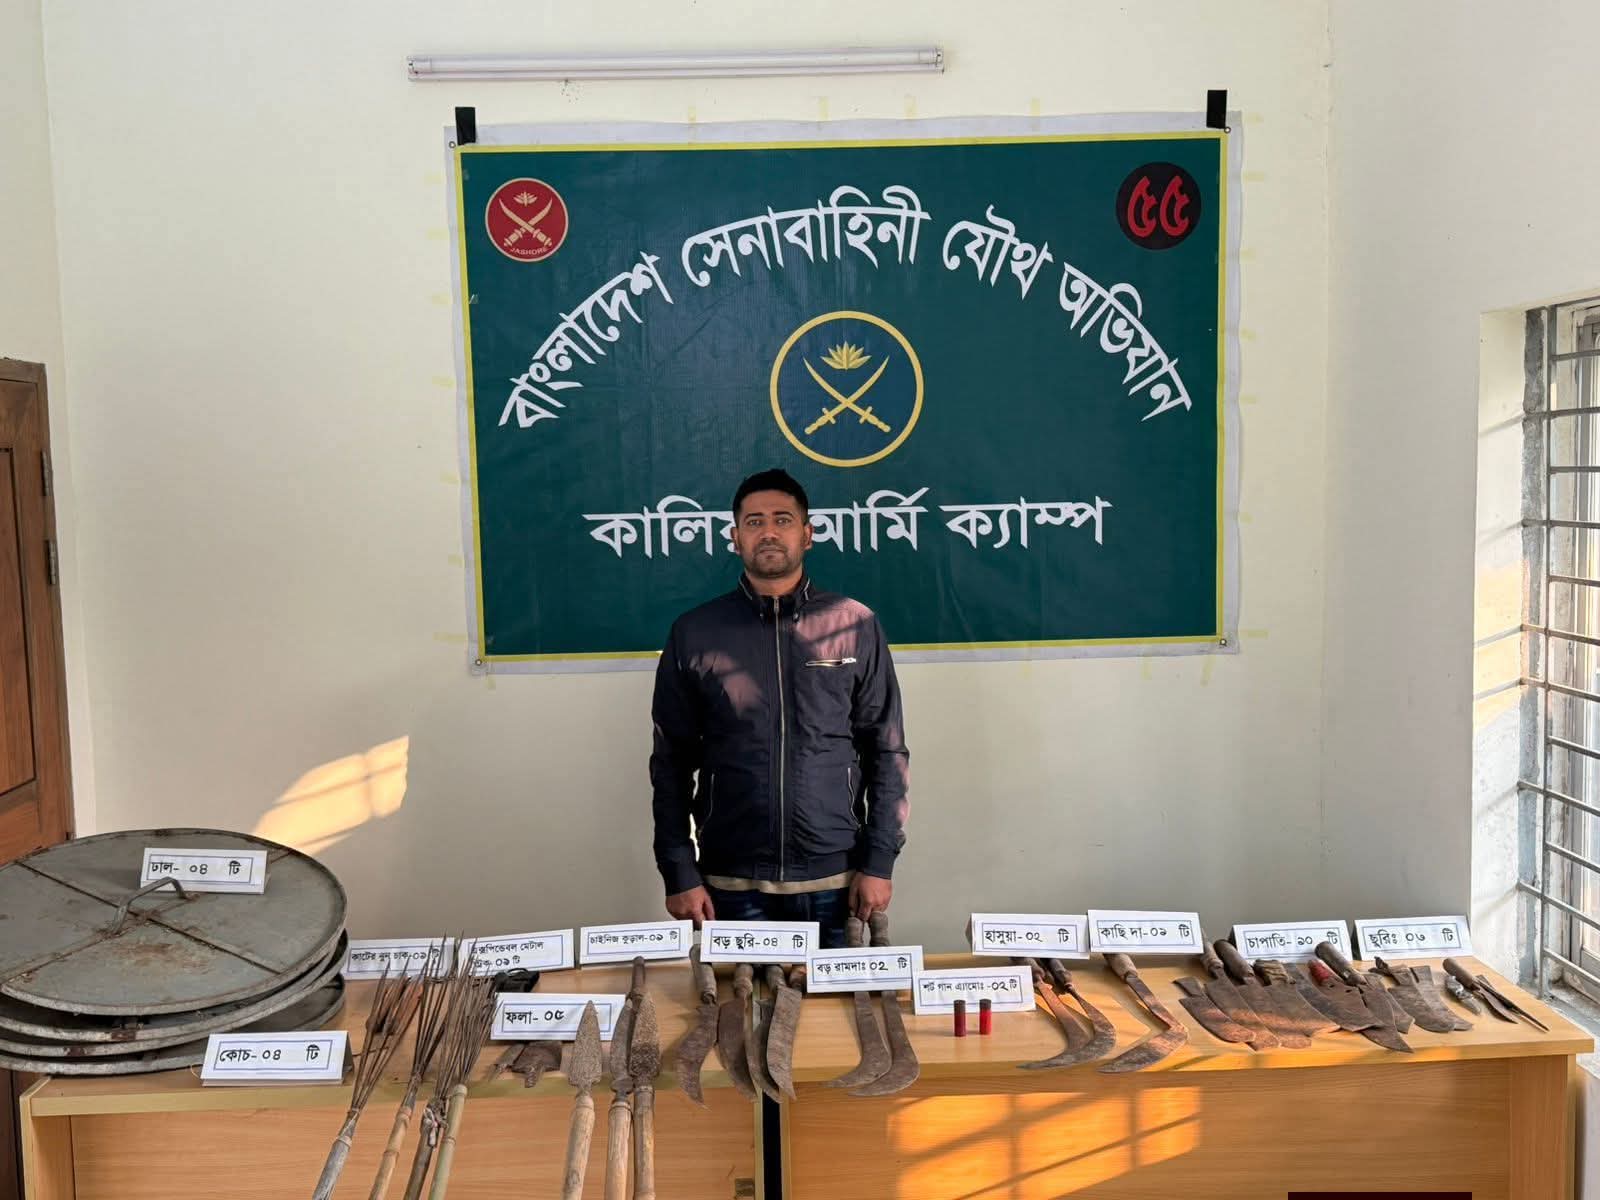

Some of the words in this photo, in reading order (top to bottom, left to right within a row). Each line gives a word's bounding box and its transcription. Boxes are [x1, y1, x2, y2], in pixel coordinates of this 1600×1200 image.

[1127, 174, 1192, 238] ৫৫
[510, 246, 548, 256] JASHORE
[498, 250, 674, 429] বাংলাদেশ
[681, 184, 932, 288] সেনাবাহিনী
[942, 204, 1054, 300] যৌথ
[1058, 261, 1193, 423] অভিযান
[808, 486, 930, 554] আর্মি
[940, 494, 1113, 550] ক্যাম্প
[189, 864, 208, 875] ০৪
[228, 860, 241, 876] টি
[669, 930, 678, 941] টি
[1057, 928, 1070, 943] টি
[1100, 923, 1128, 939] কাছি
[1178, 923, 1191, 939] টি
[1325, 930, 1339, 945] টি
[1442, 927, 1454, 944] টি
[713, 935, 731, 949] বড়
[792, 934, 805, 949] টি
[512, 954, 521, 966] টি
[816, 962, 832, 975] বড়
[897, 956, 907, 969] টি
[1009, 978, 1017, 990] টি
[544, 1009, 565, 1021] ০৫
[262, 1048, 282, 1061] ০৪
[305, 1044, 321, 1062] টি
